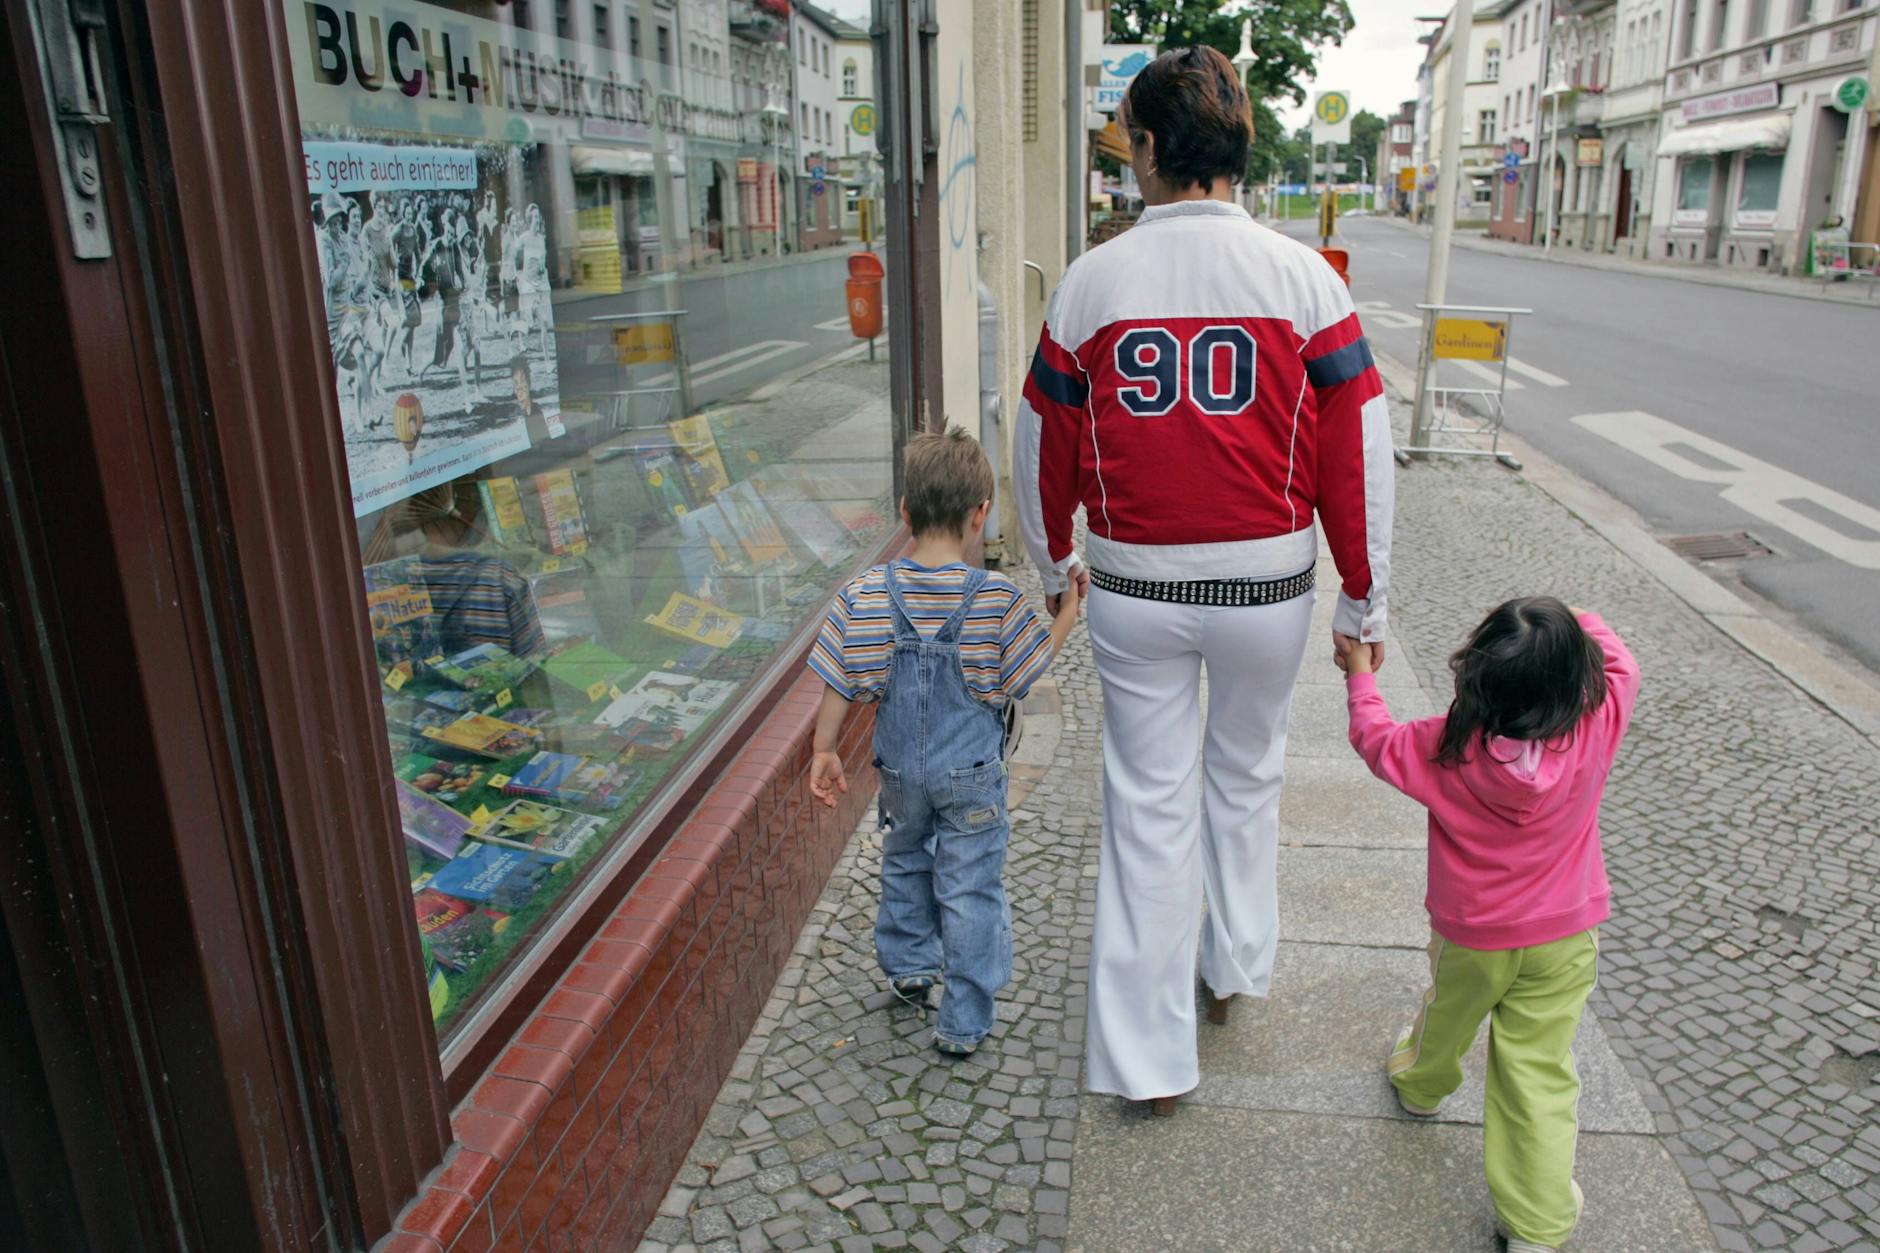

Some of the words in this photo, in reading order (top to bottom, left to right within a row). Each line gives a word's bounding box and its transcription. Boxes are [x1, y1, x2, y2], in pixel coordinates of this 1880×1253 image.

[327, 152, 366, 189] geht
[370, 154, 404, 181] auch
[409, 156, 474, 188] einfacher!
[1436, 334, 1493, 349] Gardinen
[1114, 325, 1257, 416] 90
